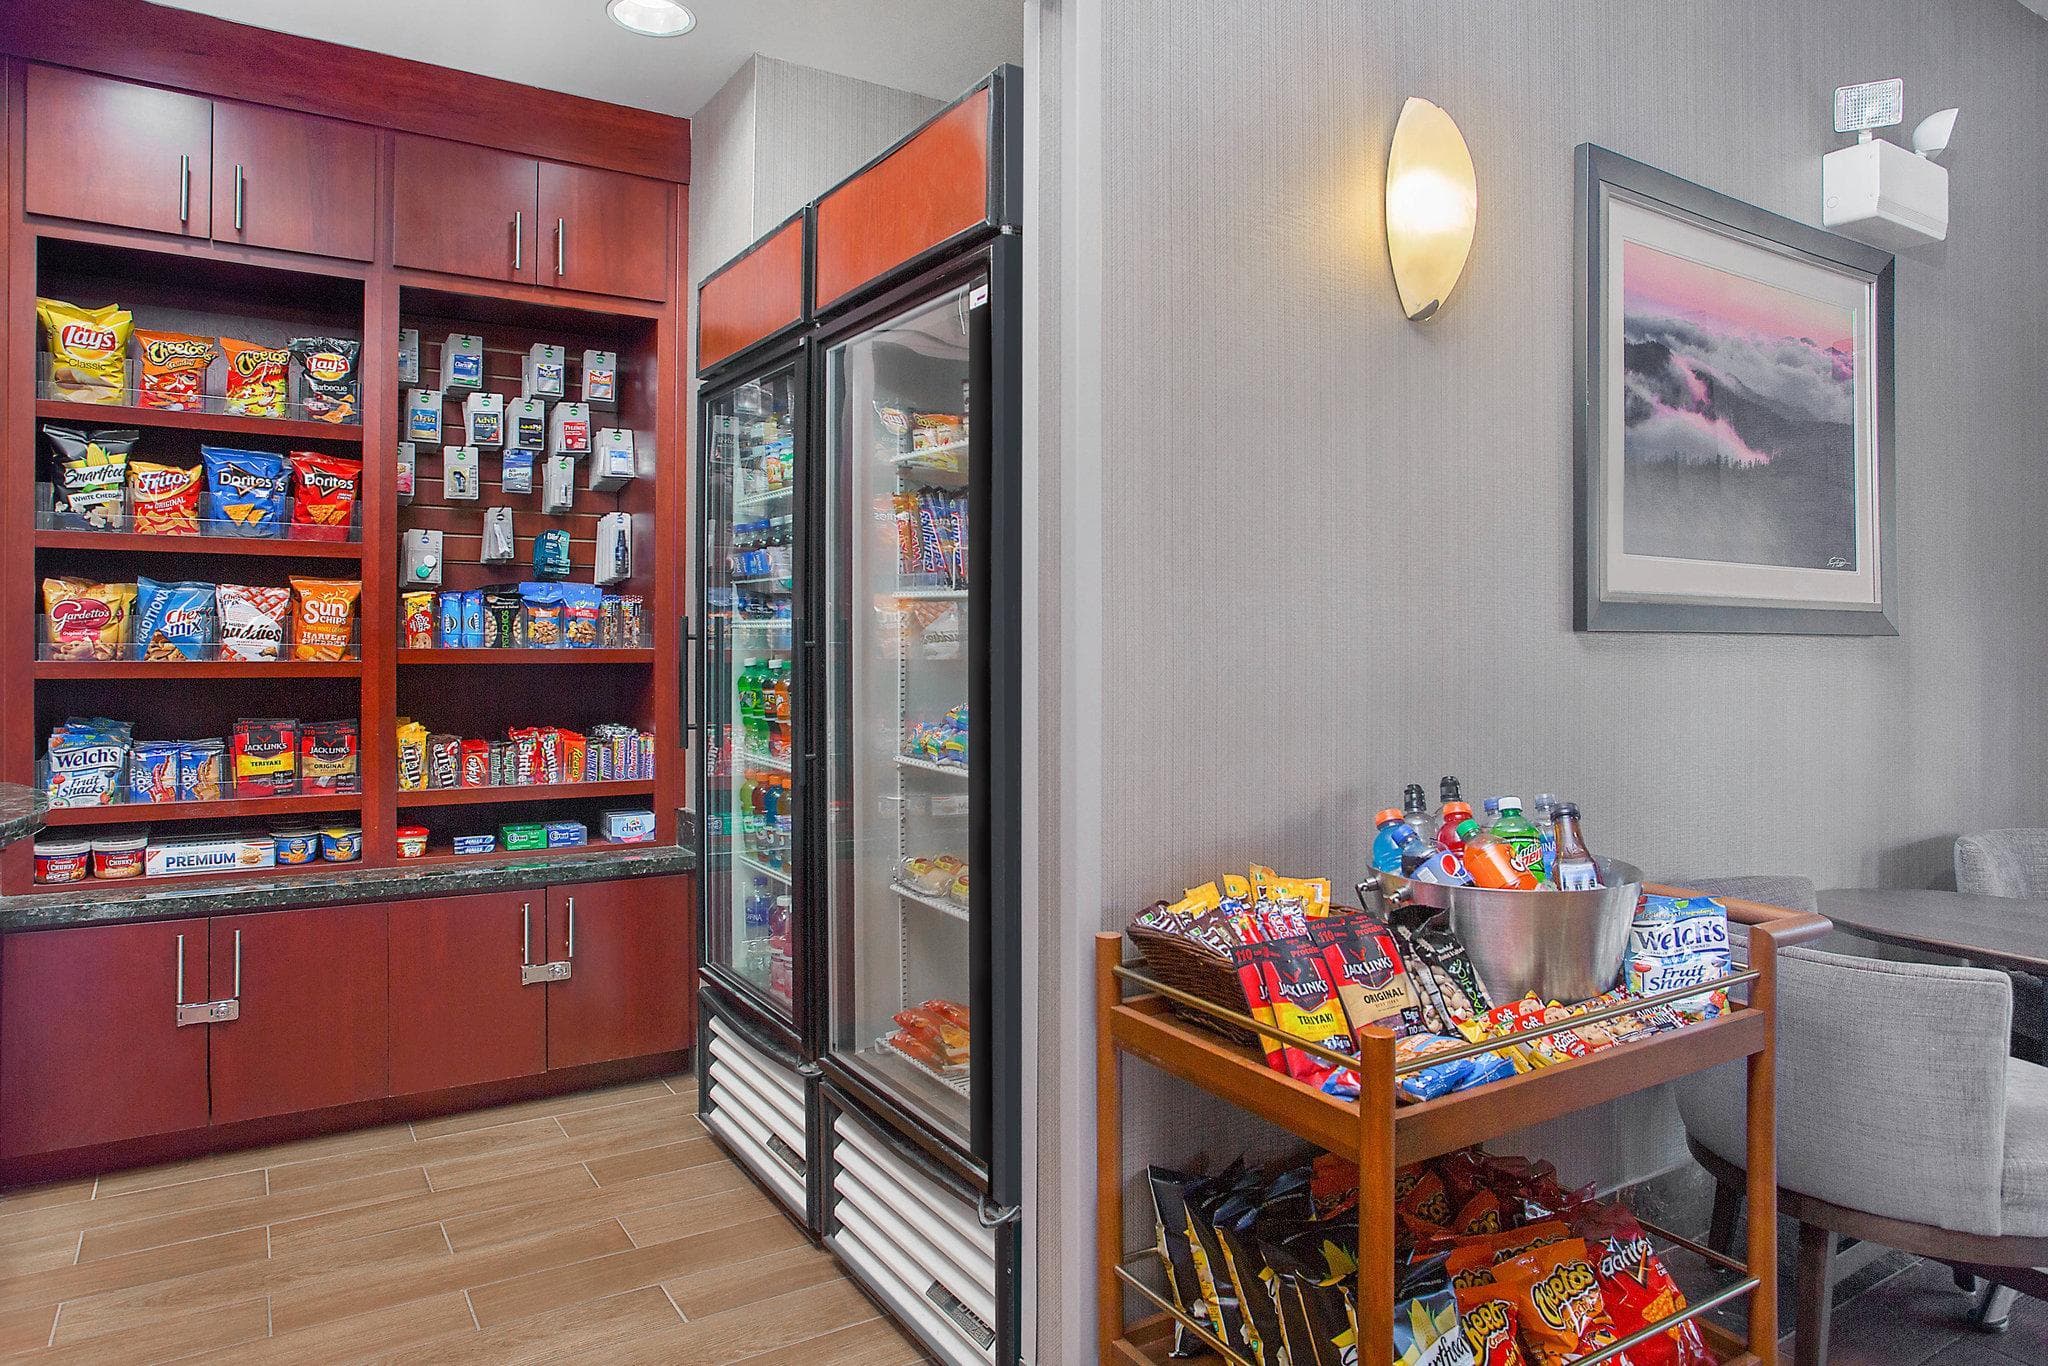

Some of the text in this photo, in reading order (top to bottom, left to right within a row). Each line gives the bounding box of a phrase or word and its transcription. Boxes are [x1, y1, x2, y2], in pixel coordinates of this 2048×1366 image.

[64, 325, 116, 351] Lay's
[147, 340, 208, 365] Cheetos
[68, 358, 106, 372] Classic
[235, 350, 290, 377] Cheetos
[311, 357, 345, 373] Lay's
[312, 383, 348, 392] Barbecue
[139, 472, 191, 492] Fritos
[219, 472, 273, 488] Doritos
[304, 472, 354, 490] Doritos
[155, 497, 187, 509] ORIGINAL
[51, 601, 110, 632] Gardetto's
[303, 599, 349, 624] Sun
[320, 616, 347, 625] CHIPS
[244, 741, 288, 753] JACK LINK'S
[309, 747, 329, 755] JACK
[56, 748, 118, 768] Welch's
[251, 759, 282, 767] TERIYAKI
[543, 740, 559, 785] Skittles
[71, 775, 100, 788] Fruit
[60, 786, 106, 798] Snacks
[165, 852, 236, 868] PREMIUM
[1635, 920, 1726, 951] Welch's
[1343, 956, 1394, 979] JACK LINK'S
[1662, 964, 1706, 980] Fruit
[1278, 981, 1301, 998] JACK
[1296, 980, 1329, 996] LINK'S
[1363, 987, 1405, 1005] ORIGINAL
[1297, 1013, 1334, 1026] TERIYAKI
[1531, 1262, 1595, 1330] Cheetos
